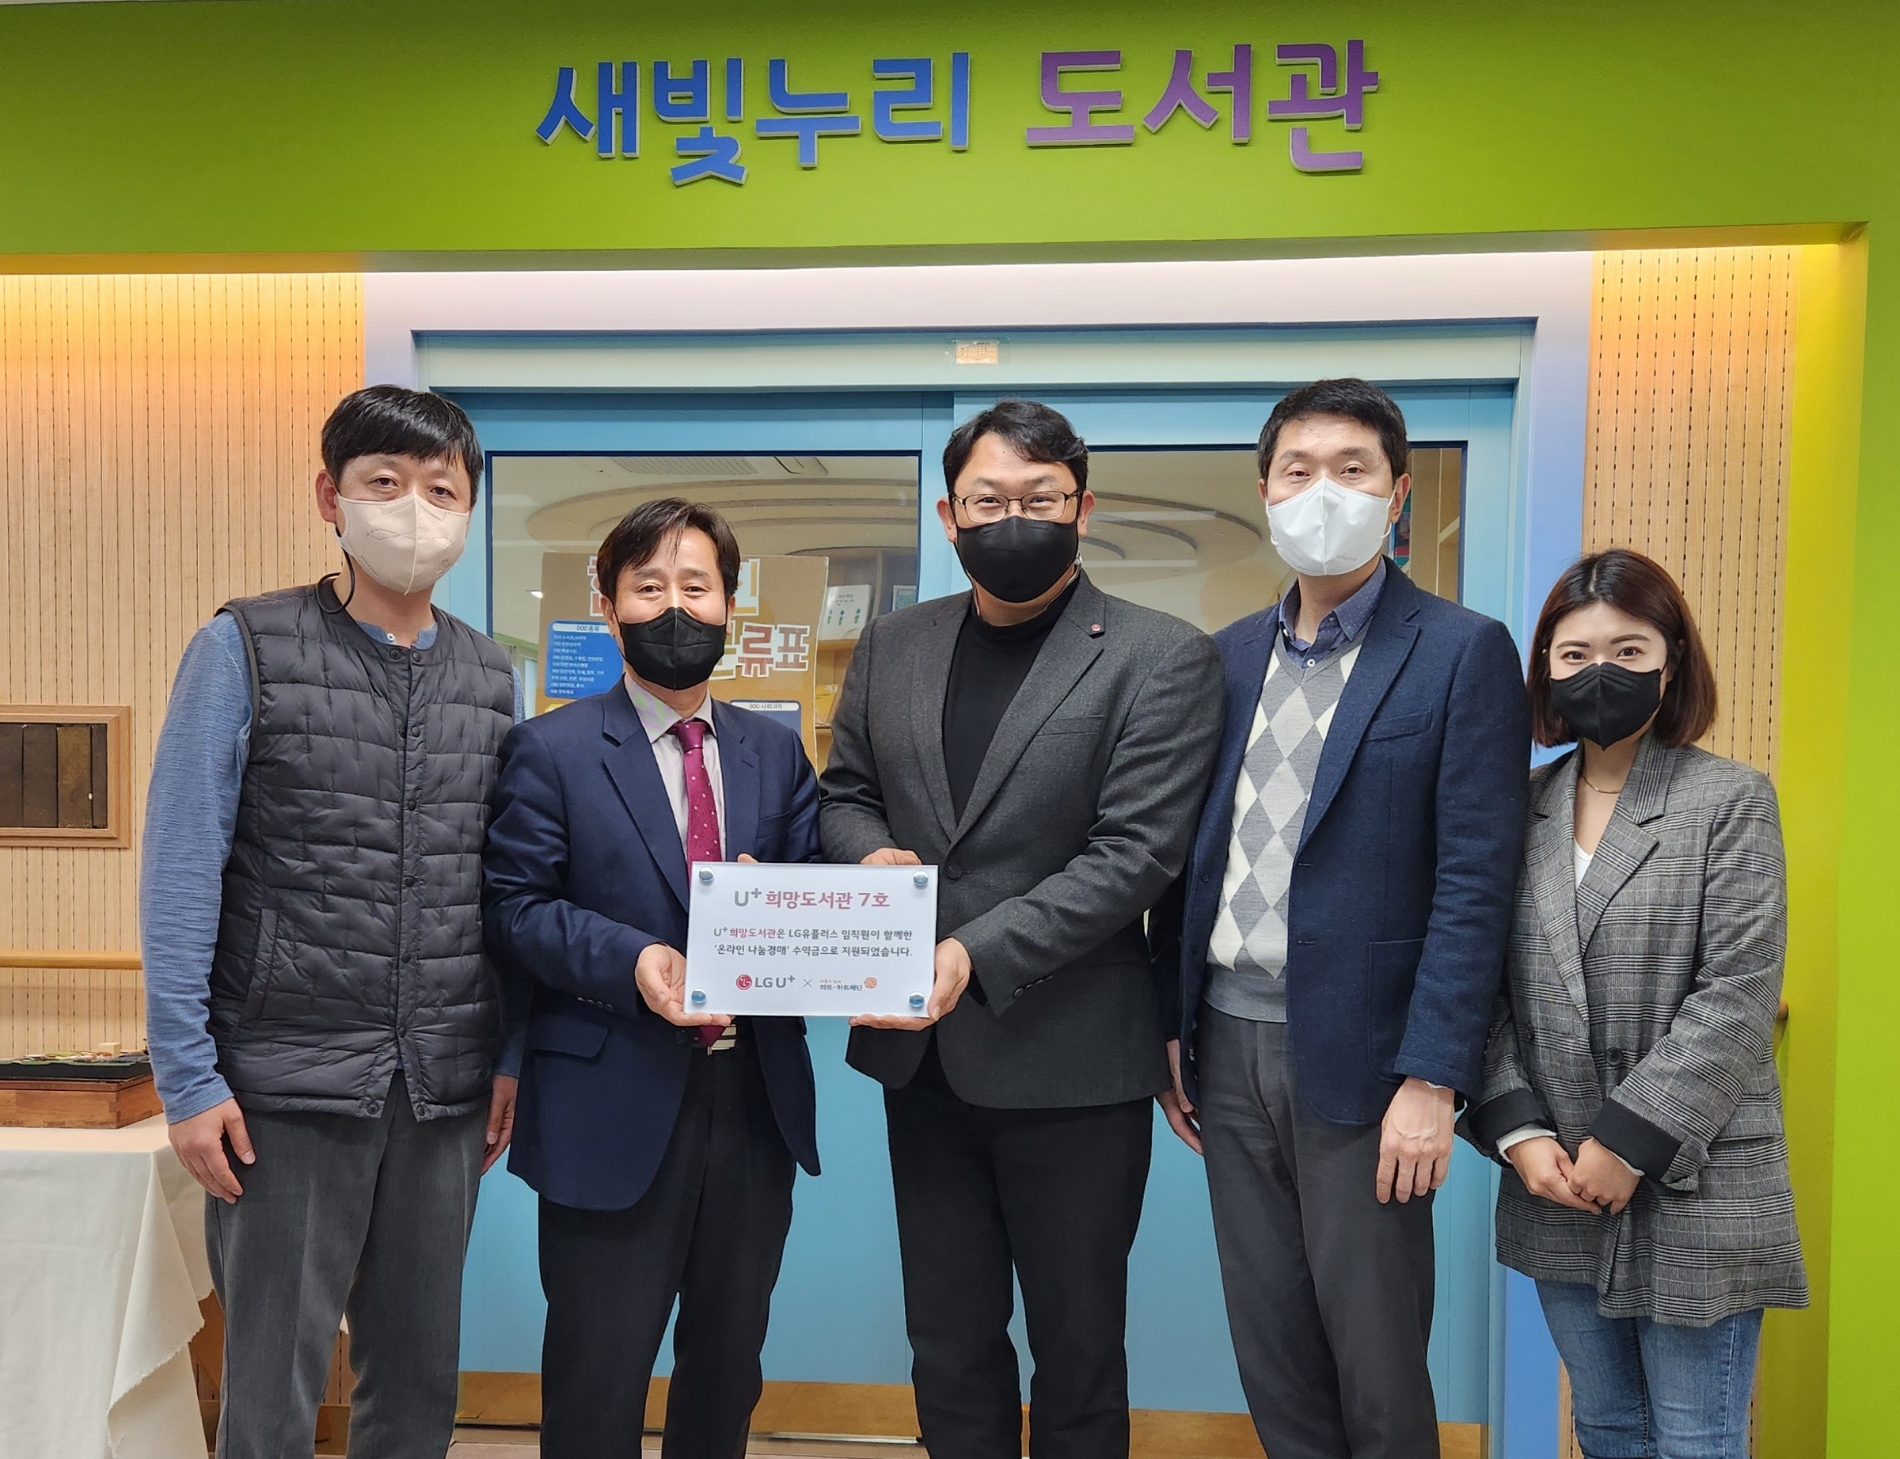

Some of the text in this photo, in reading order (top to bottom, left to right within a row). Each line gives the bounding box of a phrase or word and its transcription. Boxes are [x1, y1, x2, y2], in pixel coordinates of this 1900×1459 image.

[535, 39, 1379, 186] 새빛누리 도서관
[765, 891, 853, 910] 희망도서관
[858, 892, 890, 907] 7호
[788, 929, 839, 940] LG유플러스
[841, 930, 880, 940] 임직원이
[883, 930, 913, 941] 함께한
[792, 946, 839, 956] 수익금으로
[841, 946, 913, 957] 지원되었습니다.
